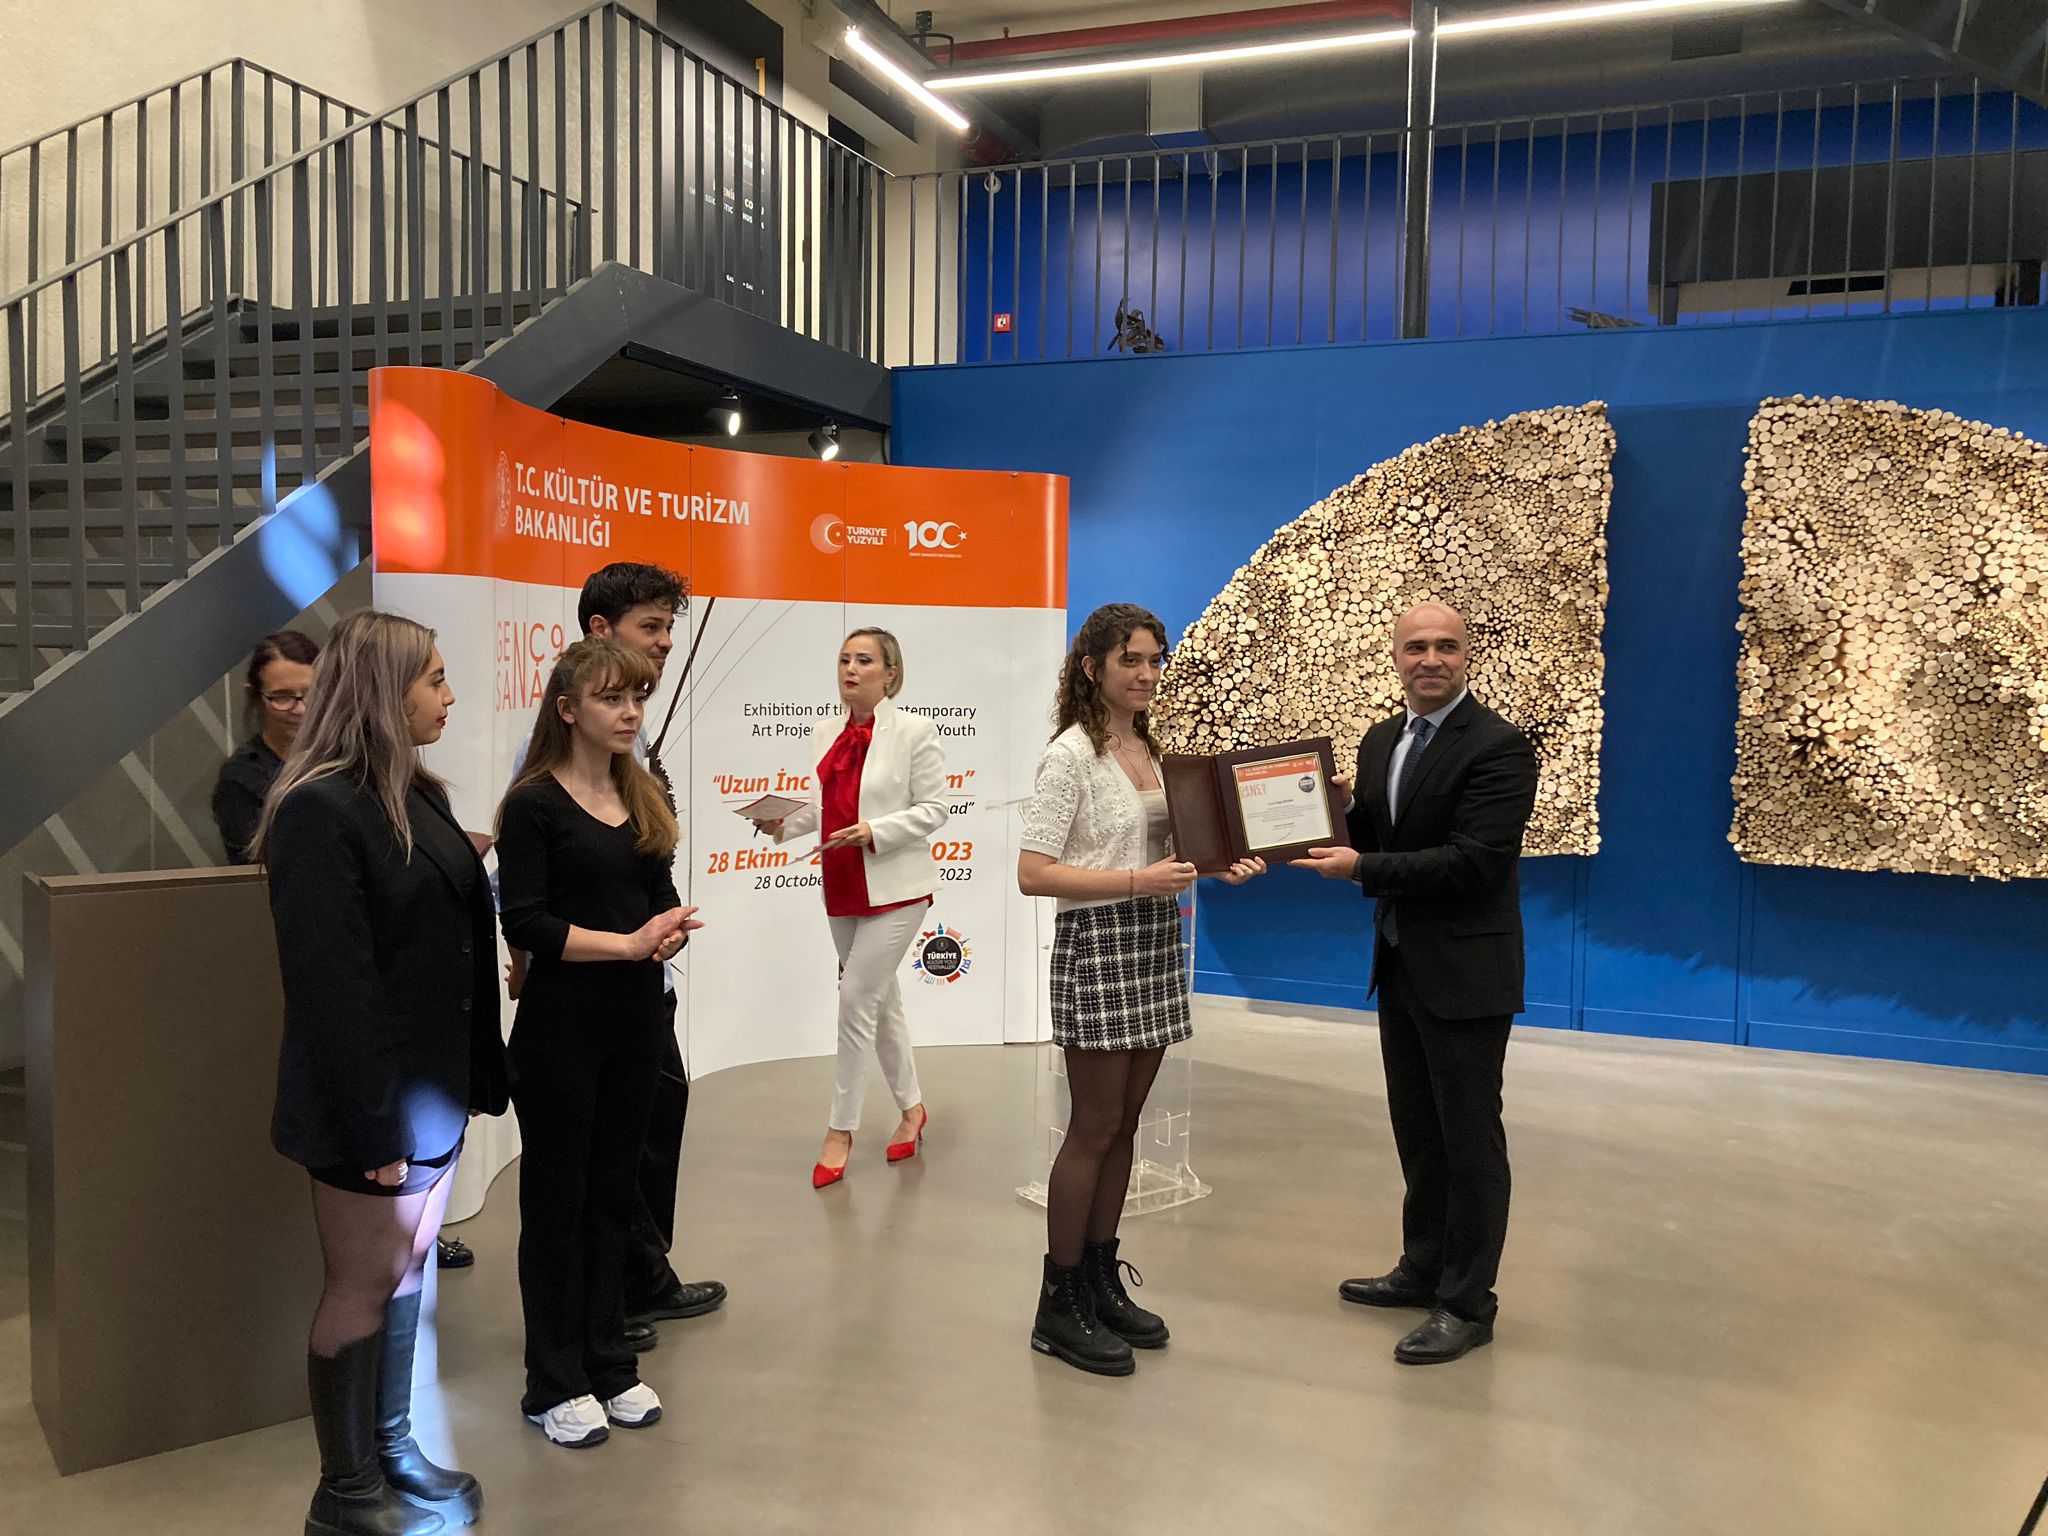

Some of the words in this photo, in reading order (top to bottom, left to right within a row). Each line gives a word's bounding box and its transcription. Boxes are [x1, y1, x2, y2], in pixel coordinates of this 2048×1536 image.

[515, 462, 540, 497] T.C.
[544, 467, 619, 511] KÜLTÜR
[624, 486, 652, 516] VE
[658, 491, 750, 526] TURİZM
[515, 505, 611, 548] BAKANLIĞI
[496, 667, 555, 713] SANA
[744, 702, 813, 717] Exhibition
[816, 702, 831, 717] of
[752, 724, 772, 737] Art
[776, 723, 814, 740] Proje
[935, 724, 976, 737] Youth
[774, 767, 811, 792] İnc
[707, 851, 730, 875] 28
[734, 846, 789, 871] Ekim
[927, 841, 974, 861] 023
[754, 875, 771, 890] 28
[775, 874, 824, 888] Octobe
